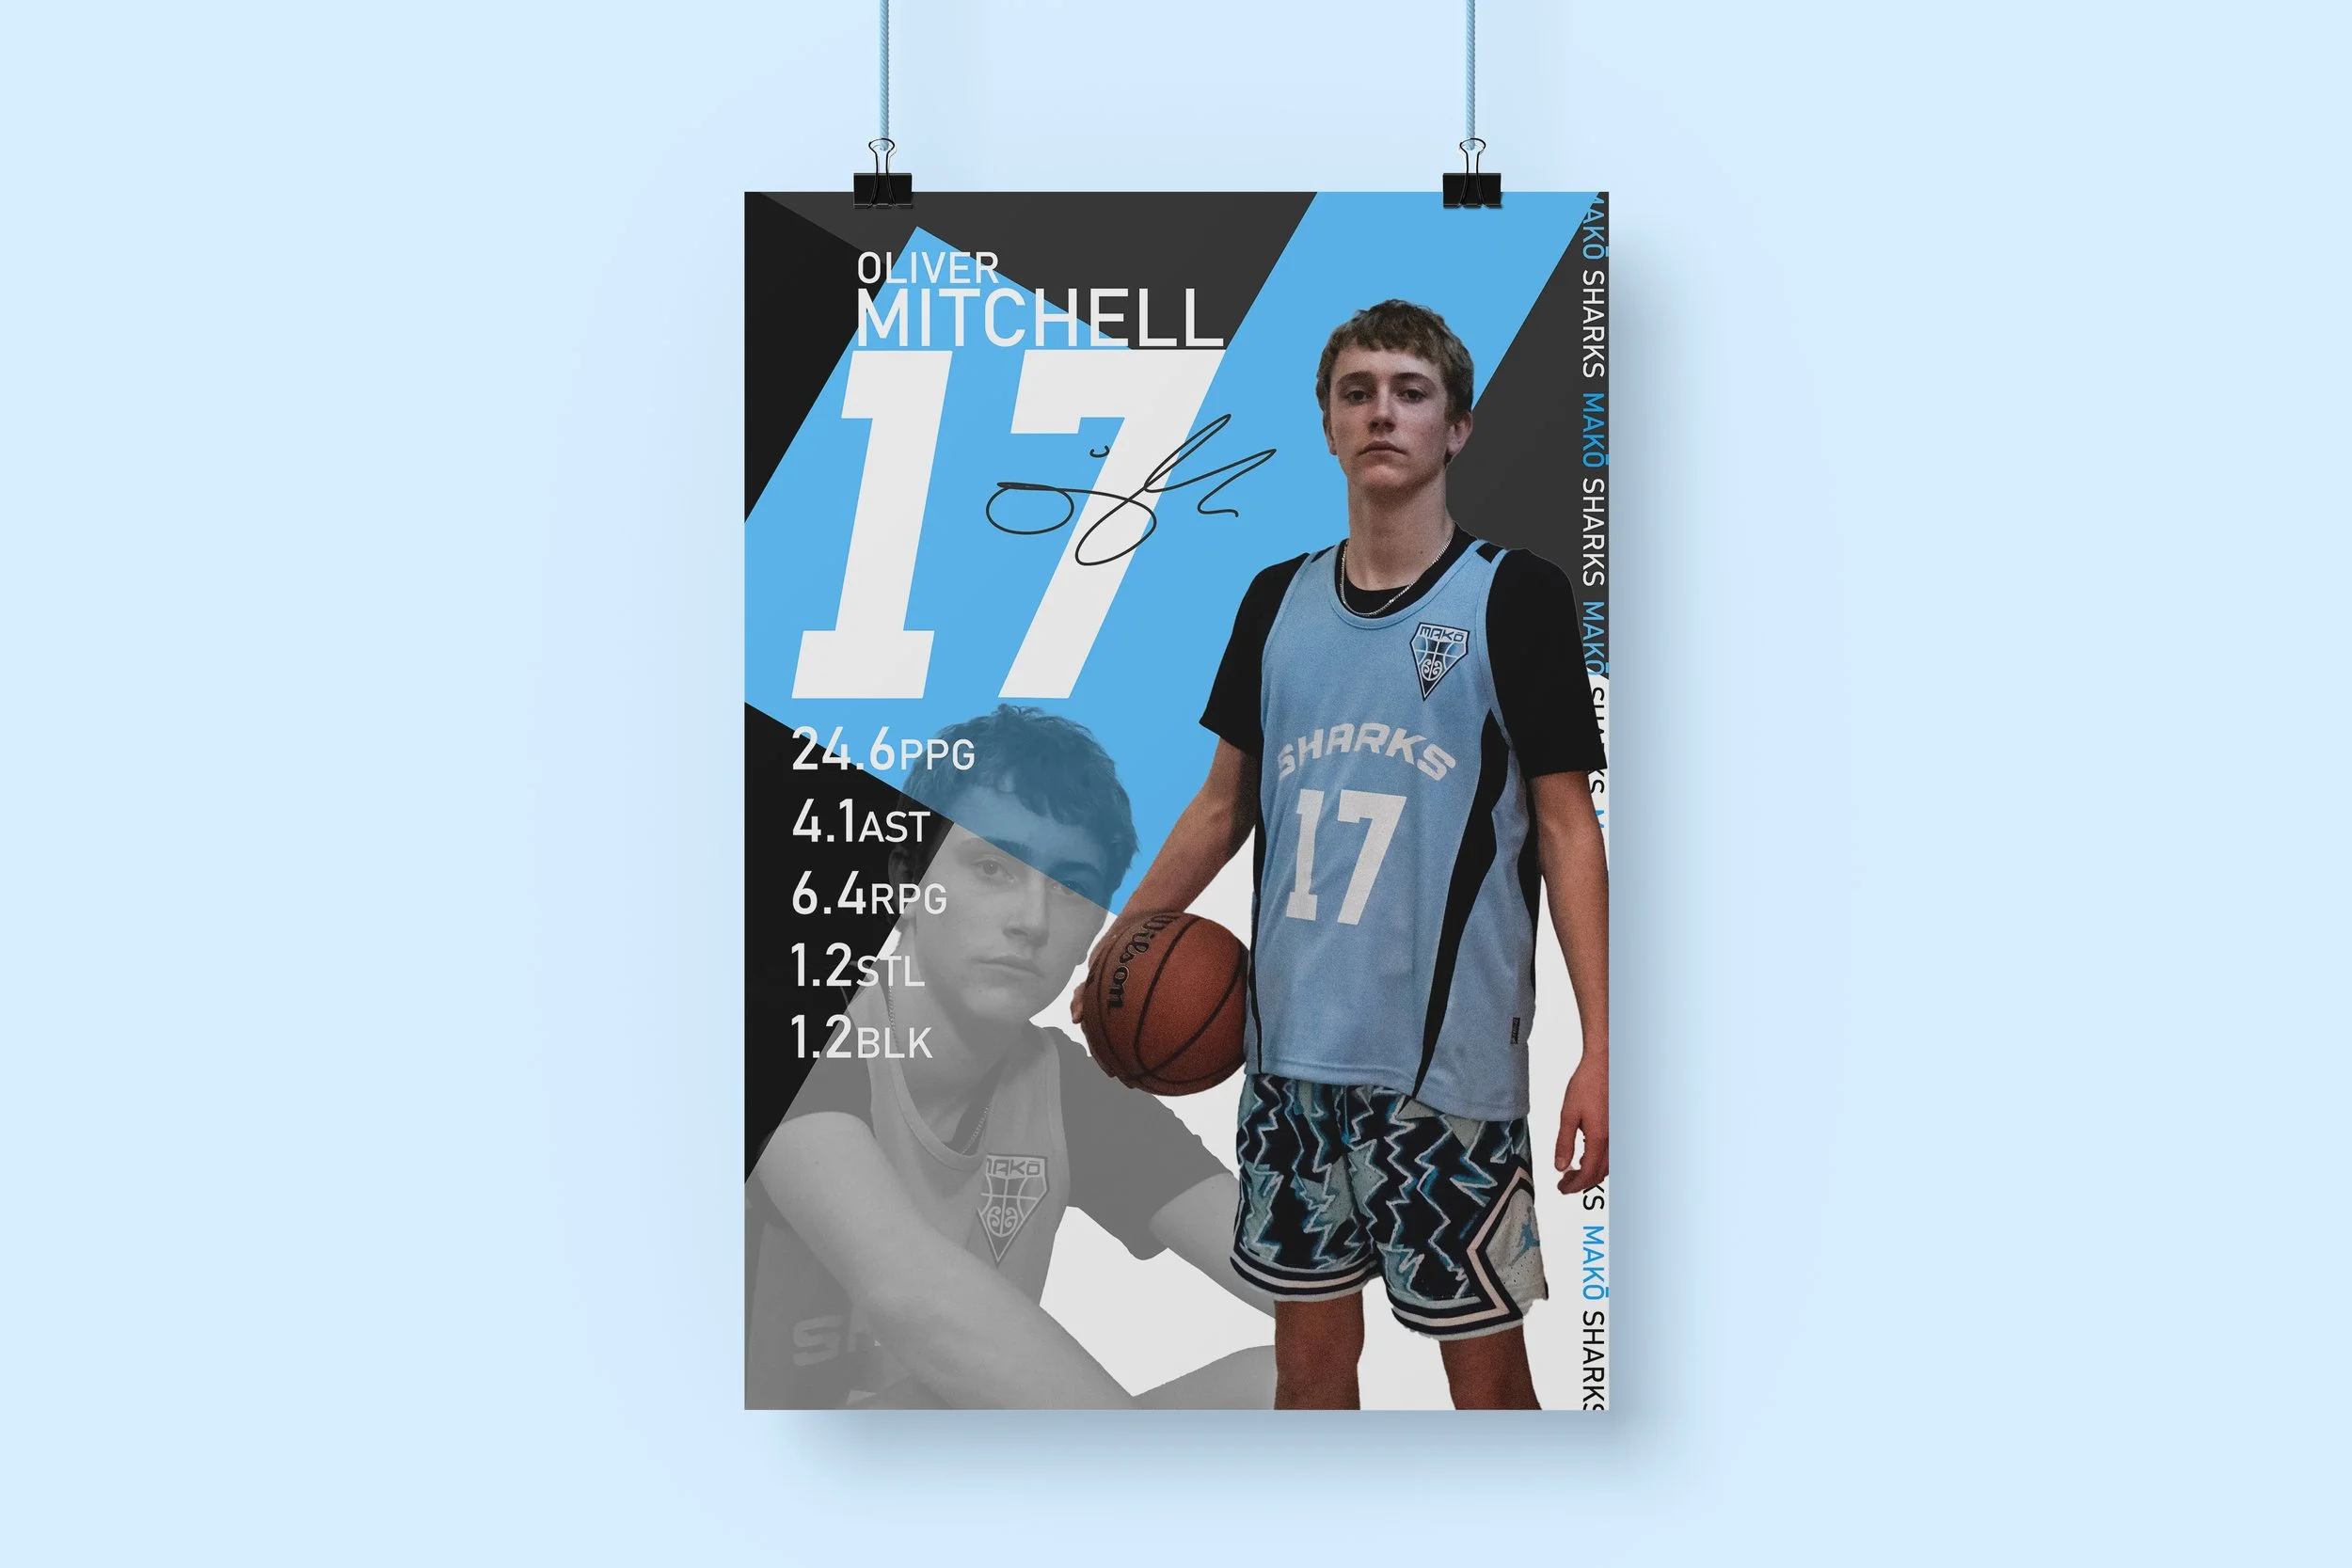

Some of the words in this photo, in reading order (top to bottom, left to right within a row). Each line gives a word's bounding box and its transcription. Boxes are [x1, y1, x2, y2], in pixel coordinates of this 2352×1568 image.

[859, 251, 999, 284] OLIVER
[858, 288, 1224, 347] MITCHELL
[1583, 270, 1604, 378] SHARKS
[791, 349, 1226, 699] 17
[1583, 478, 1604, 586] SHARKS
[792, 726, 975, 769] 24.6PPG
[1278, 722, 1456, 781] SHARKS
[792, 799, 930, 842] 4.1AST
[1286, 789, 1407, 926] 17
[792, 871, 947, 914] 6.4RPG
[791, 943, 925, 987] 1.2STL
[791, 1015, 933, 1058] 1.2BLK
